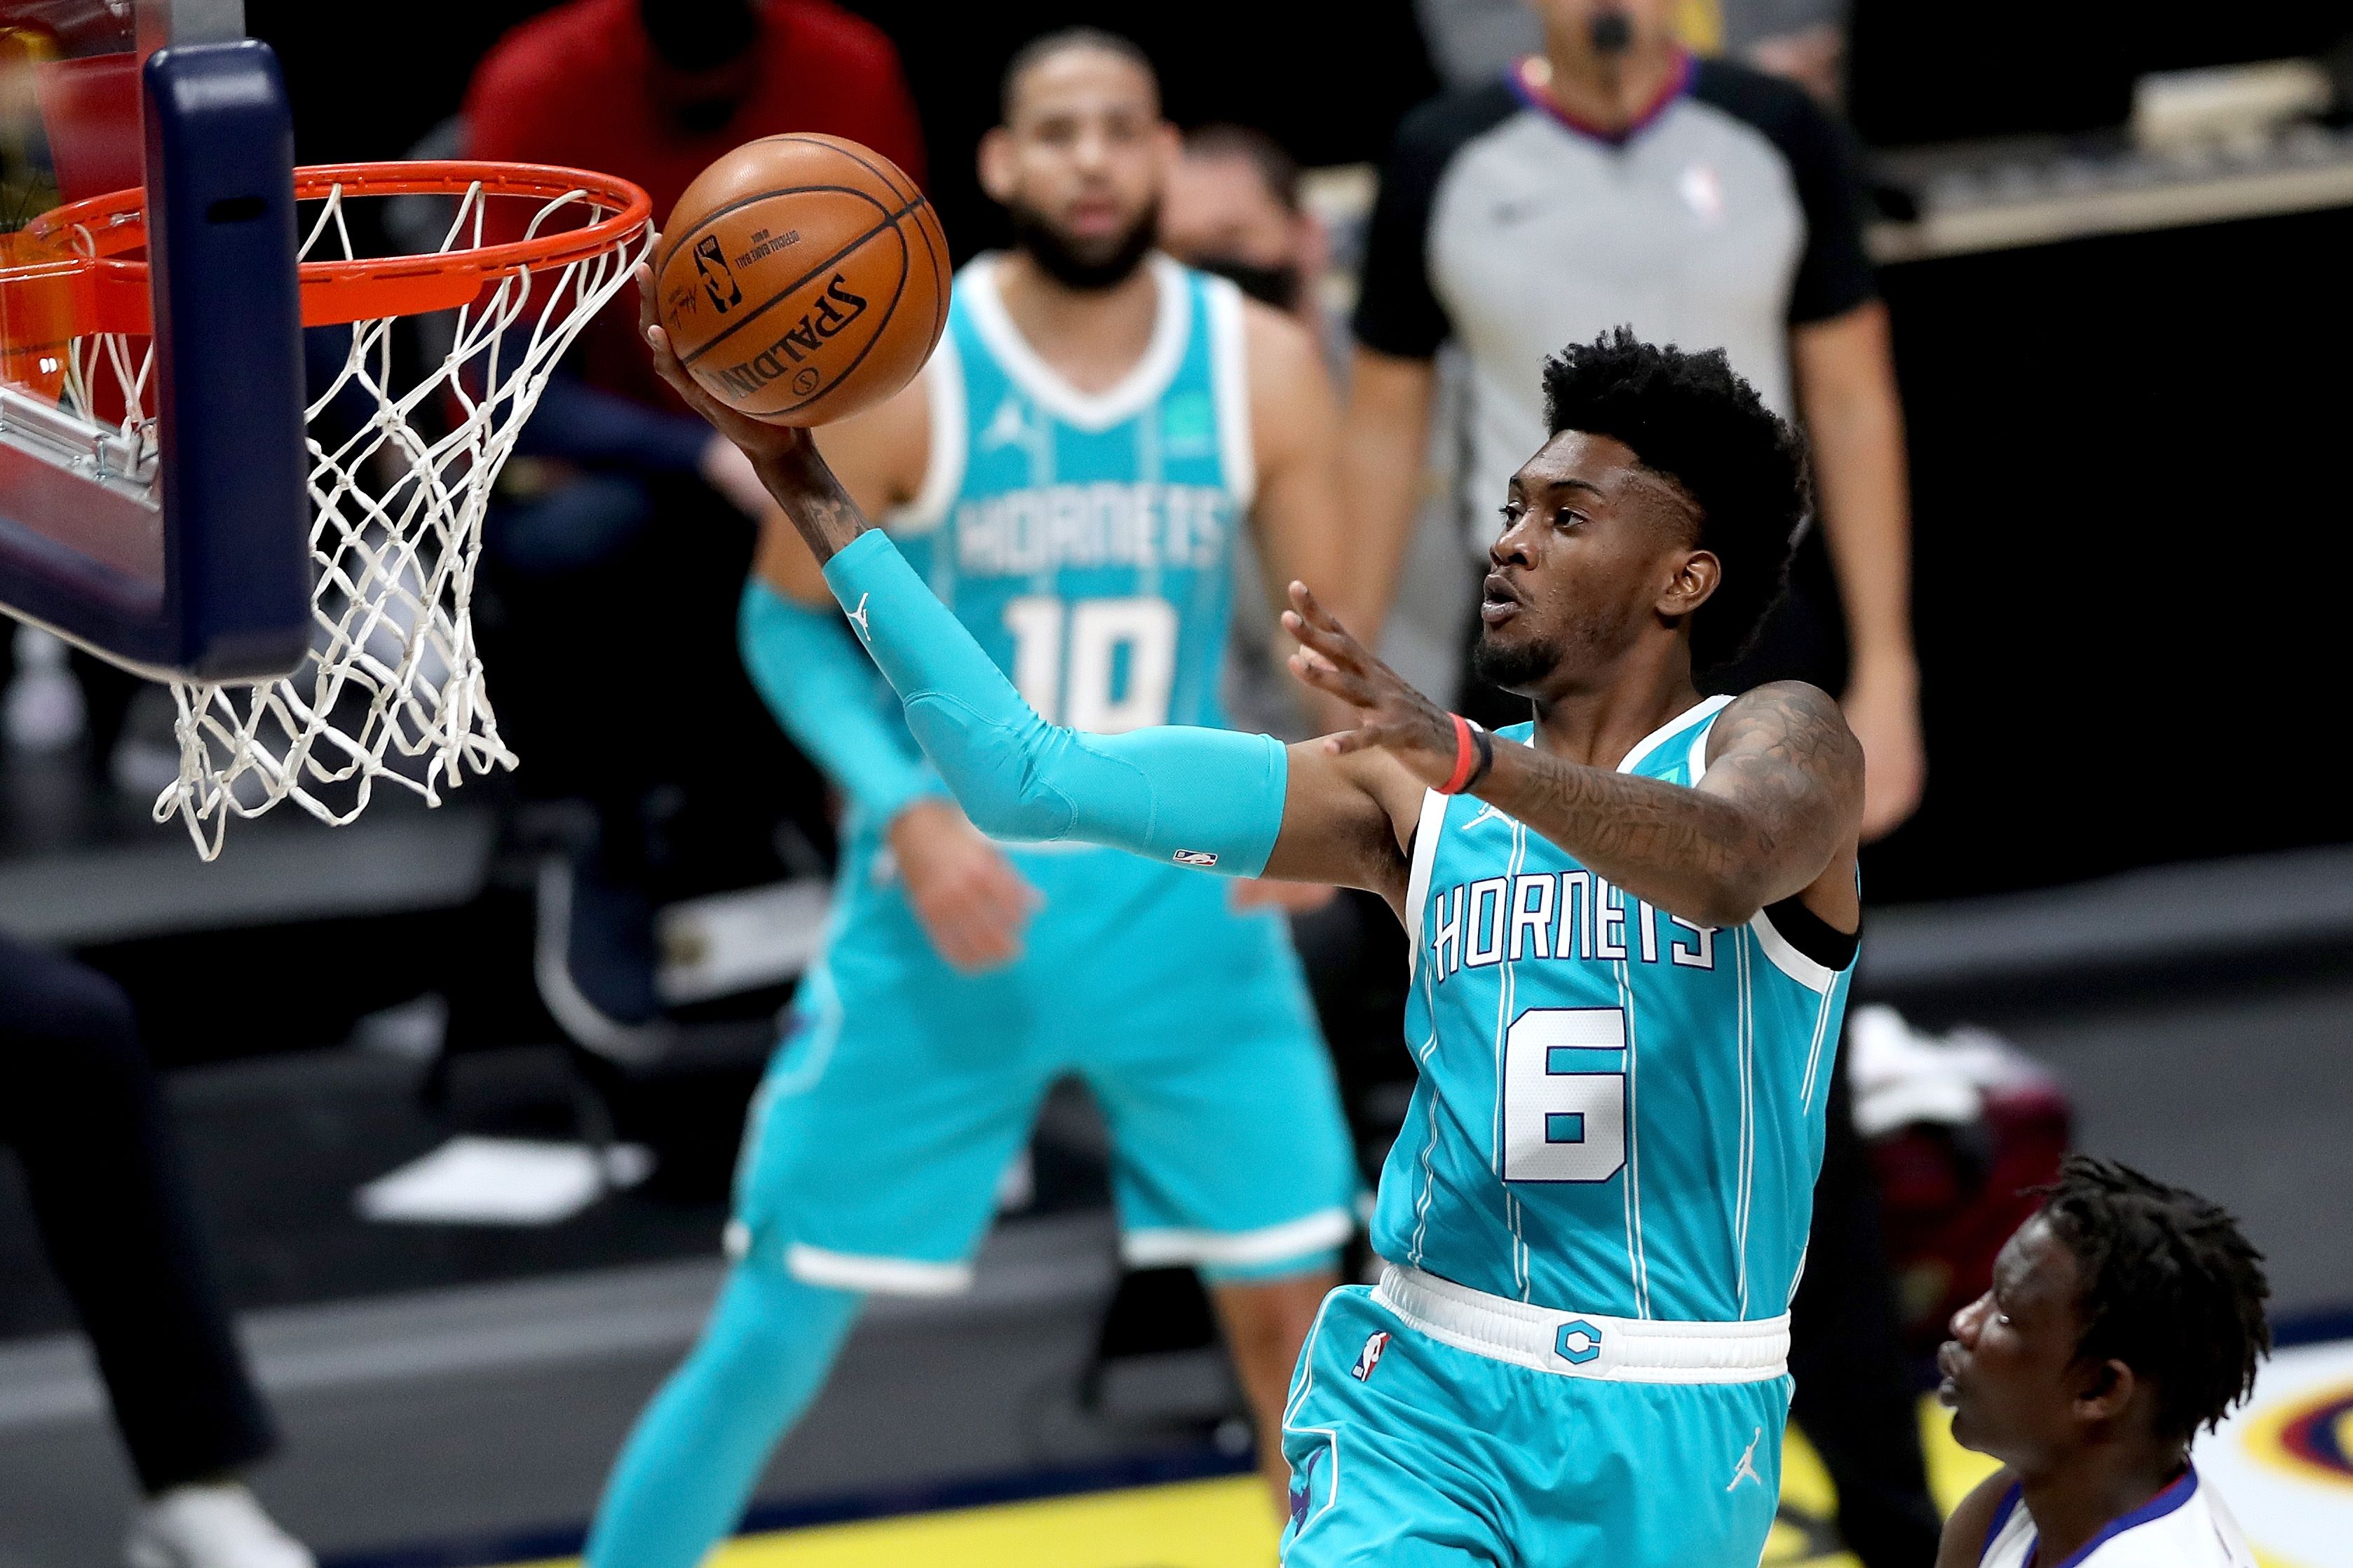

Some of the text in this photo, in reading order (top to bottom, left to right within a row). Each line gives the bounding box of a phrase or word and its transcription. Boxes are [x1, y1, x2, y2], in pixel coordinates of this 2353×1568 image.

[734, 252, 753, 269] BALL
[750, 243, 771, 262] GAME
[768, 229, 800, 252] OFFICIAL
[958, 484, 1227, 573] HORNETS
[1004, 596, 1177, 733] 10
[1503, 1007, 1627, 1182] 6
